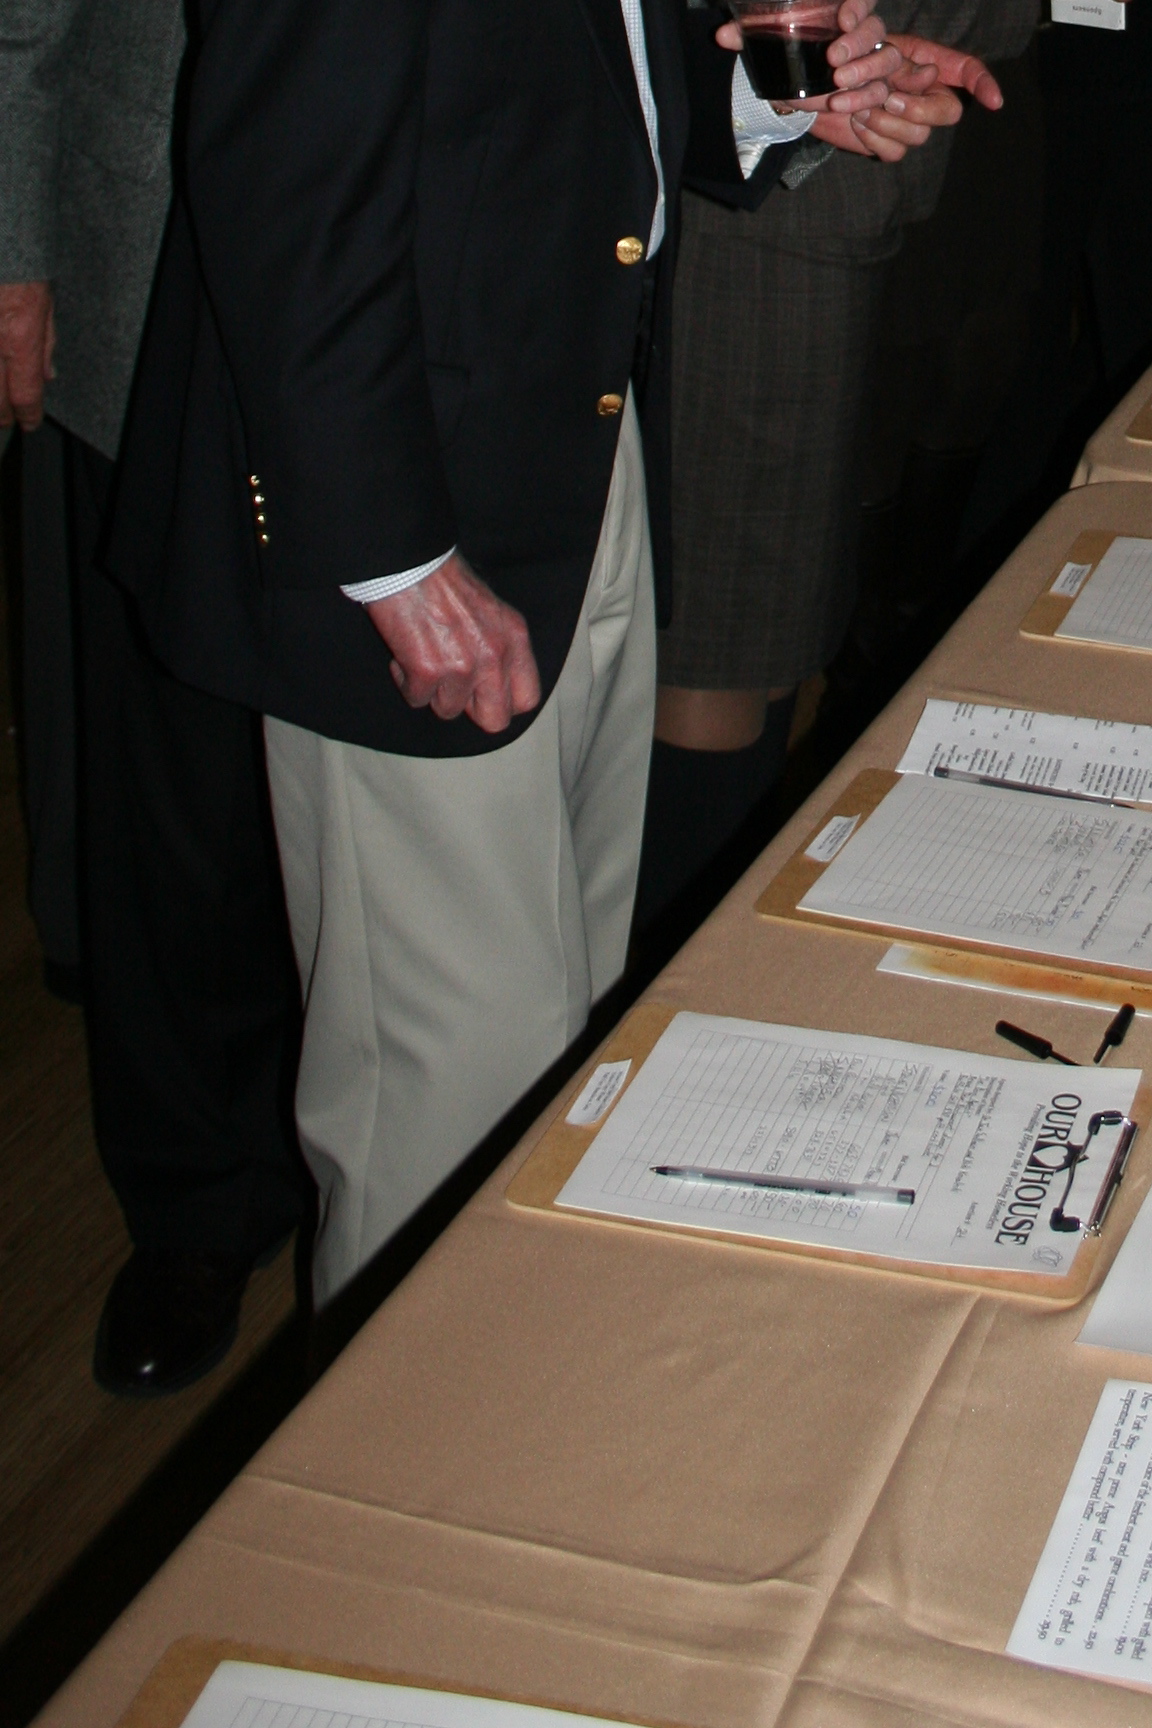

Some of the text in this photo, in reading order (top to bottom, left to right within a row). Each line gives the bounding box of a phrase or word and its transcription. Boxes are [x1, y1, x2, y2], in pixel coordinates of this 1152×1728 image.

[985, 1103, 1046, 1230] Providing Hope to the Working Homeless
[995, 1093, 1081, 1245] OUR HOUSE
